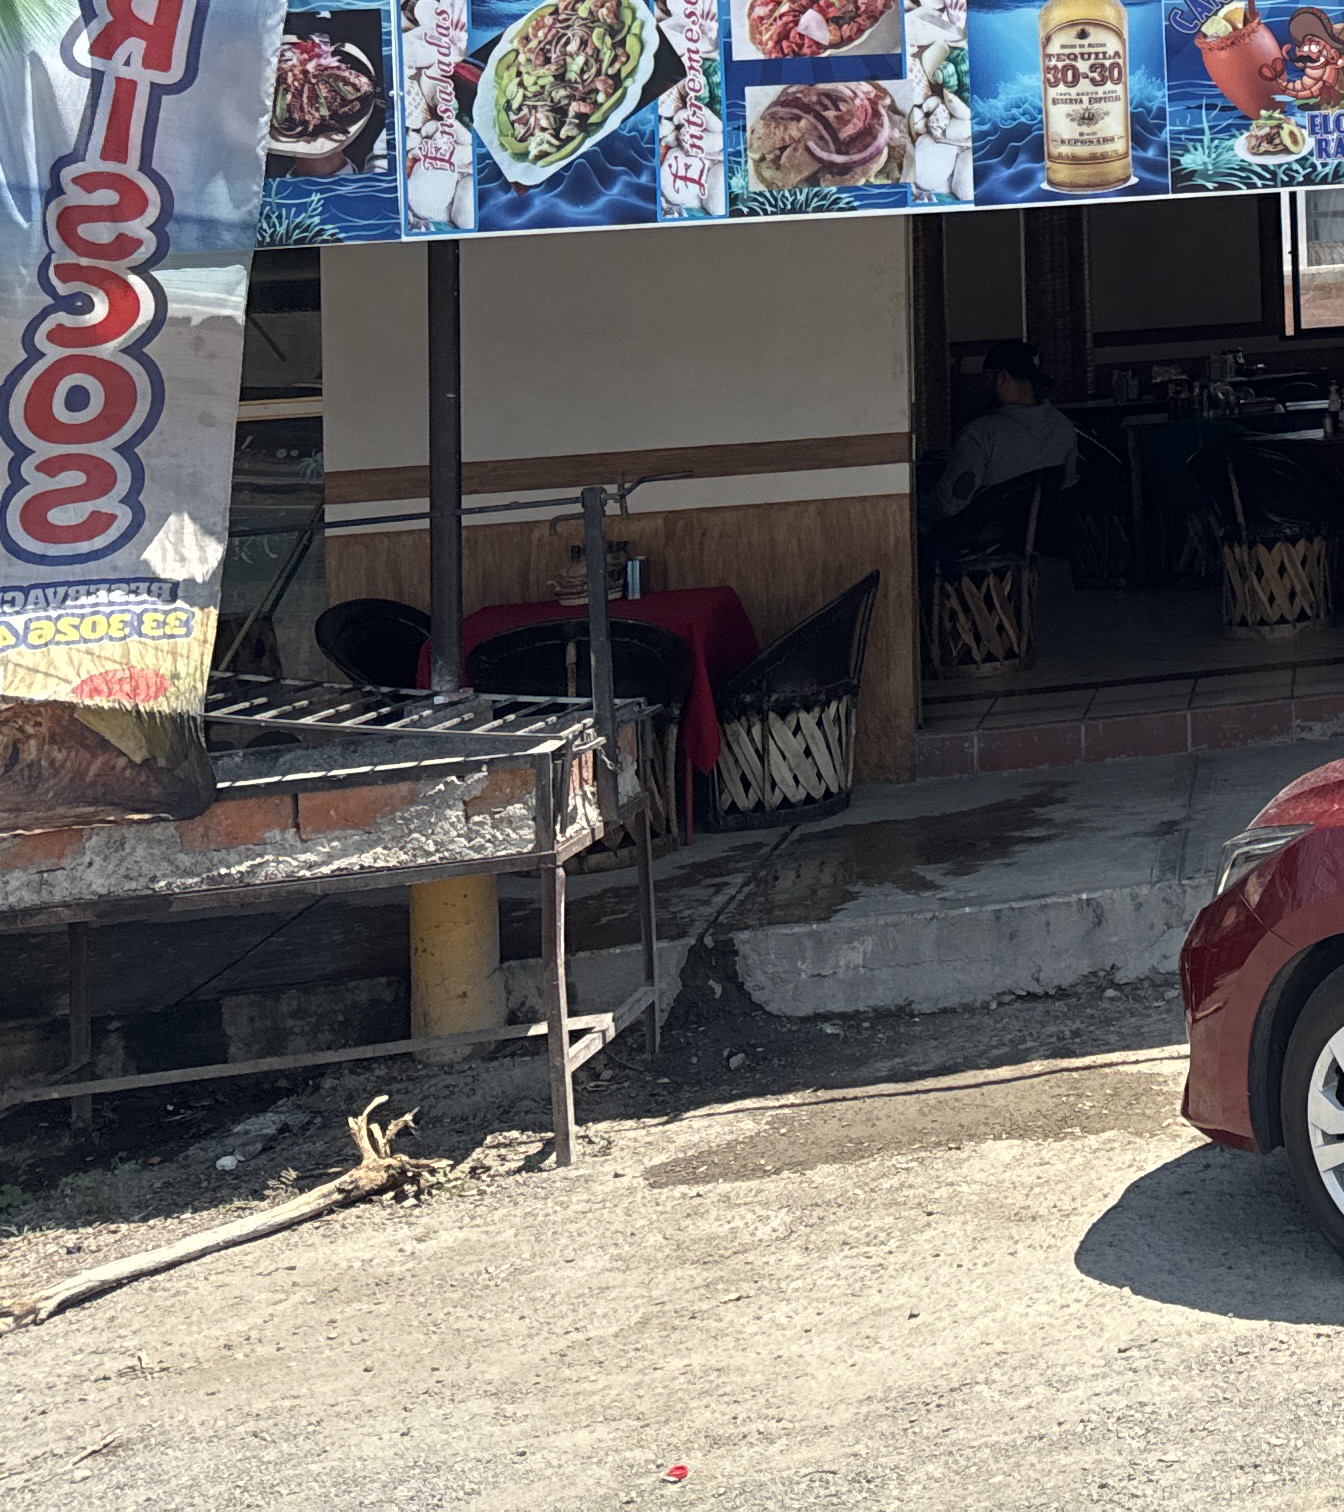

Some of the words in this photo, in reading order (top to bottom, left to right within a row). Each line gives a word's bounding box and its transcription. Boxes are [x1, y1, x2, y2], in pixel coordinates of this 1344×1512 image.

[1045, 50, 1121, 63] TEQUILA
[1046, 61, 1122, 88] 30-30
[421, 6, 456, 172] Ensaladas
[1308, 113, 1332, 135] EL
